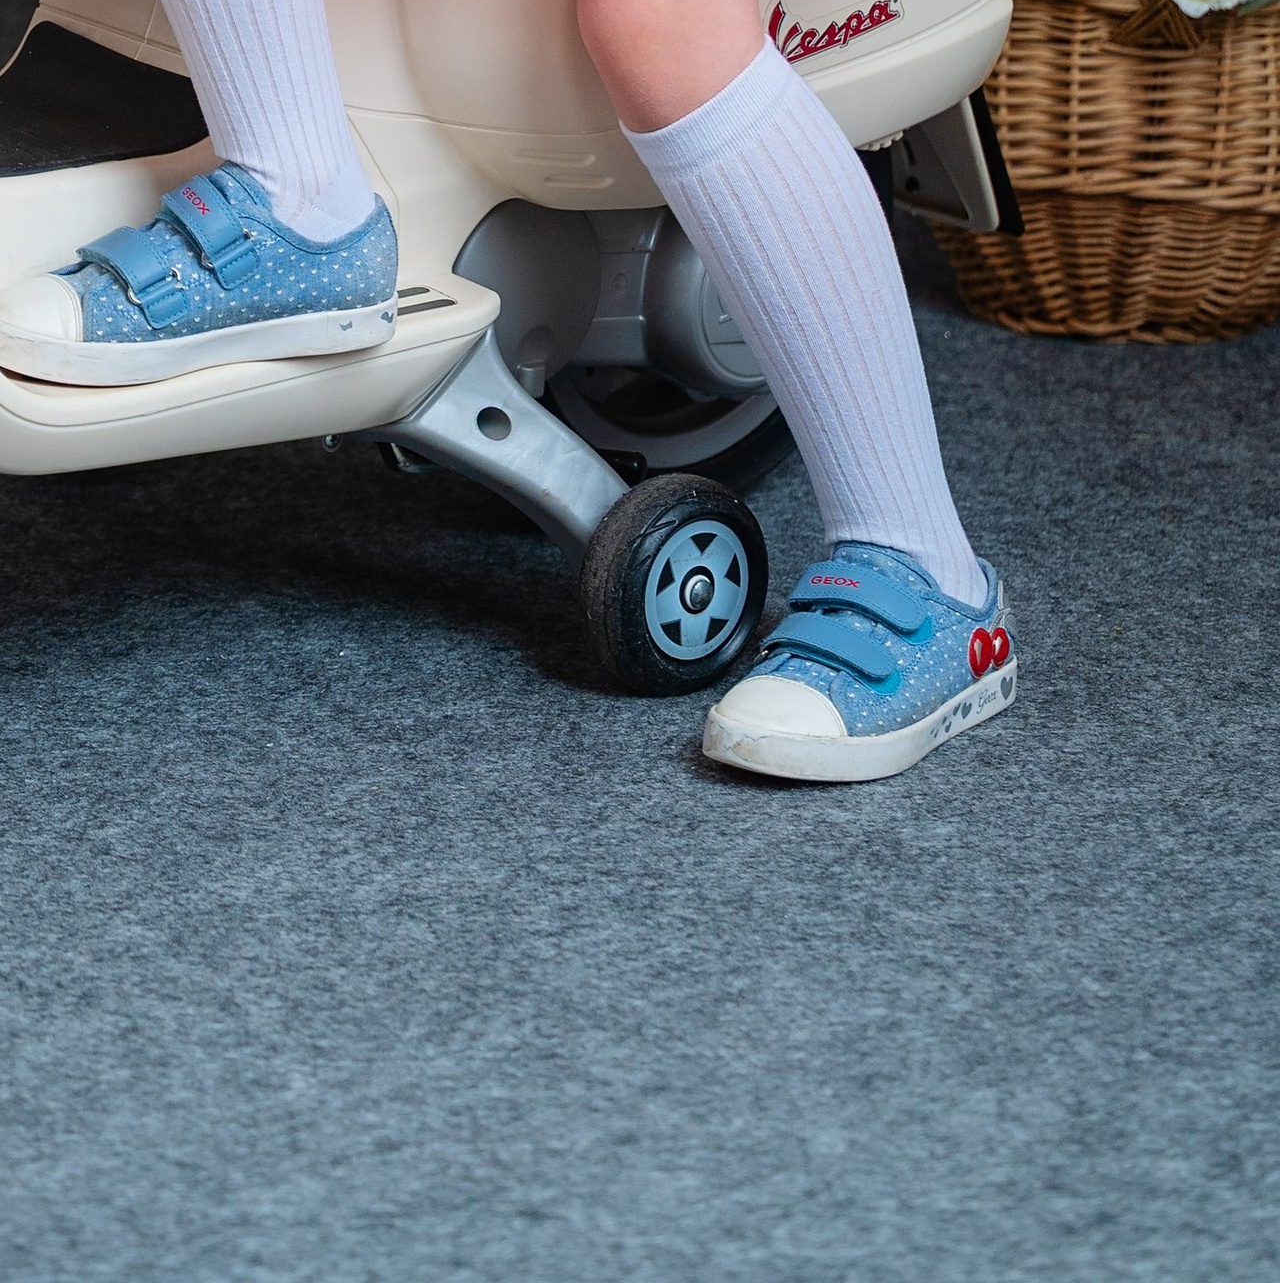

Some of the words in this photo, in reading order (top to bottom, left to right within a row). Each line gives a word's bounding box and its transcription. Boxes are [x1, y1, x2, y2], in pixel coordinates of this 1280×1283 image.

[768, 0, 901, 65] Vespa
[181, 186, 211, 216] GEOX
[810, 575, 862, 589] GEOX
